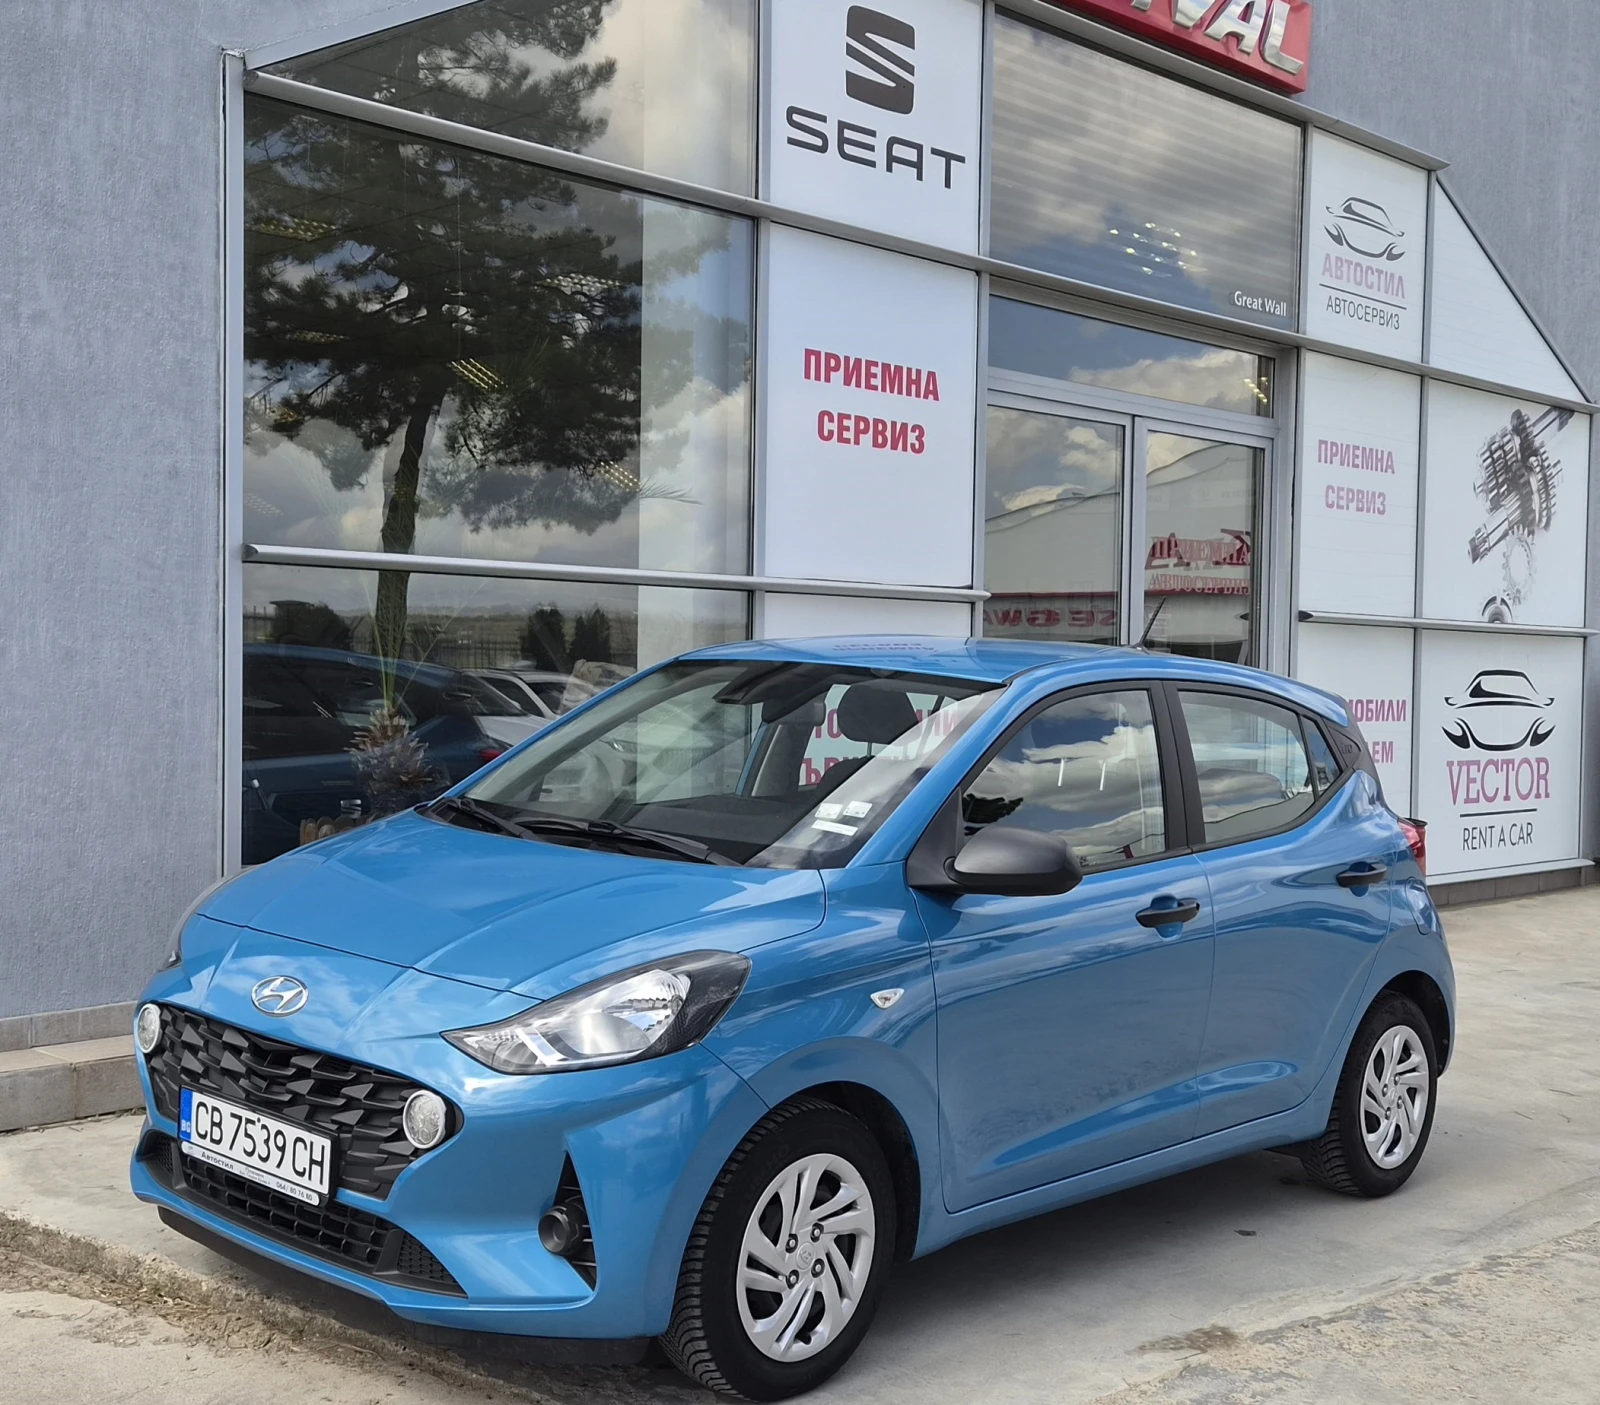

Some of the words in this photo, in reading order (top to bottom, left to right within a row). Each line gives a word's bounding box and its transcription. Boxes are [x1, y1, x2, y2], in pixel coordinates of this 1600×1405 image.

[785, 105, 966, 190] SEAT
[1322, 253, 1406, 299] АВТОСТИЛ
[1234, 290, 1263, 312] Great
[1264, 297, 1287, 317] Wall
[1325, 295, 1401, 331] АВТОСЕРВИЗ
[803, 347, 941, 402] ПРИЕМНА
[817, 409, 926, 455] СЕРВИЗ
[1317, 439, 1395, 475] ПРИЕМНА
[1325, 484, 1387, 516] СЕРВИЗ
[1372, 741, 1394, 764] ЕМ
[1446, 757, 1550, 806] VECTOR
[1462, 825, 1495, 851] RENT
[1497, 828, 1507, 848] A
[1509, 822, 1534, 846] CAR
[181, 1119, 191, 1133] BG
[229, 1113, 287, 1168] 7539
